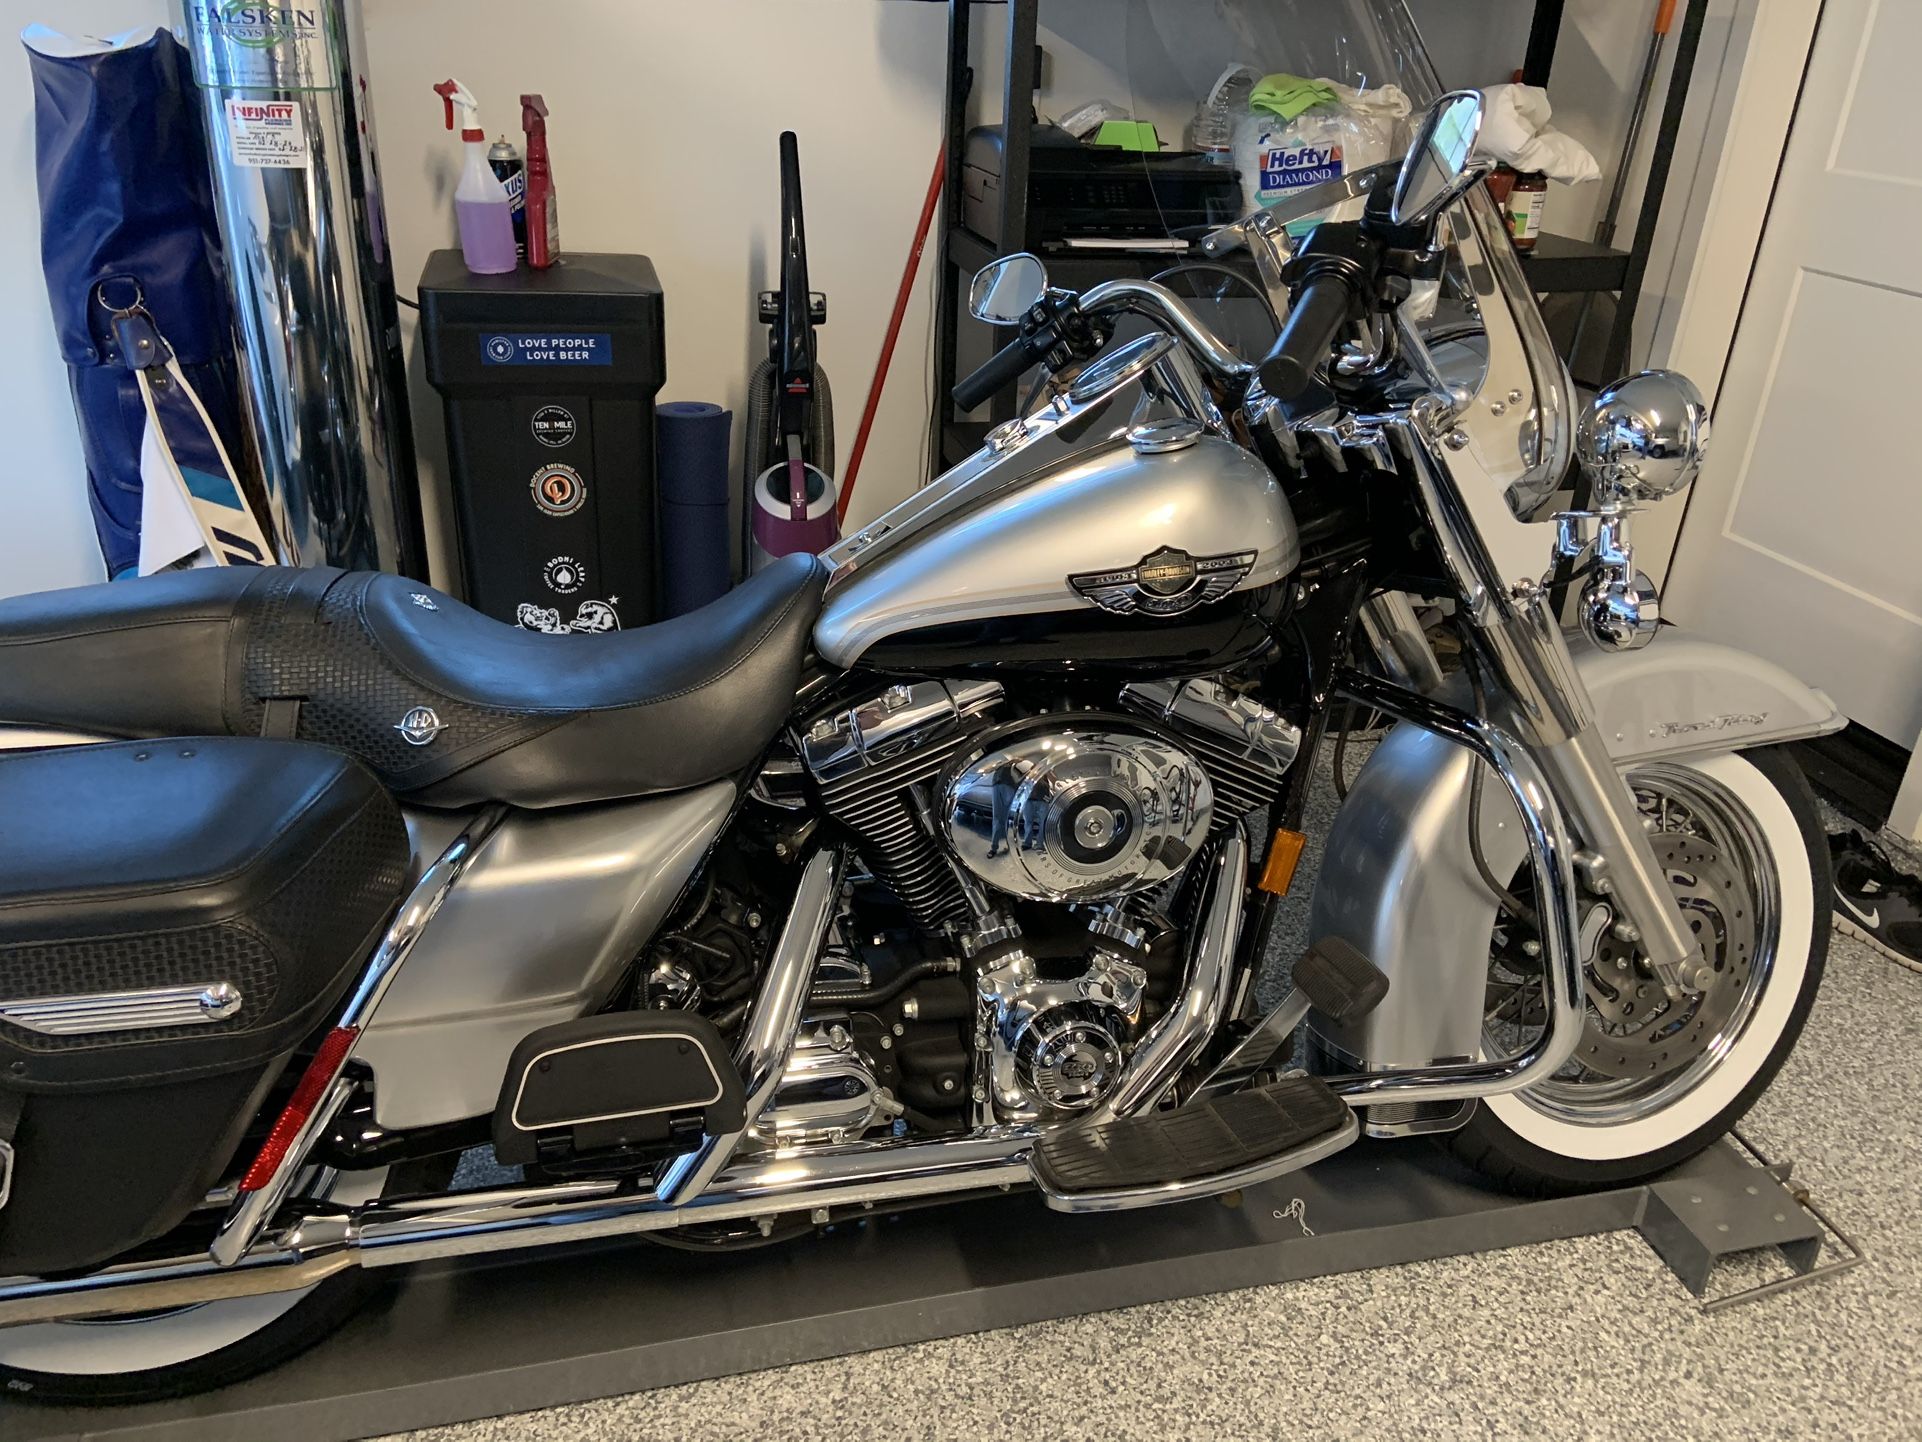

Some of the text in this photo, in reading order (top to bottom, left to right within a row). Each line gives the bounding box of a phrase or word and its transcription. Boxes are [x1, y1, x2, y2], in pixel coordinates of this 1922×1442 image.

[194, 6, 316, 27] FALSKEN
[196, 27, 236, 37] WATER
[231, 104, 293, 121] INFINITY
[1269, 148, 1330, 169] Hefty
[504, 174, 523, 197] XUS
[1269, 168, 1332, 187] DIAMOND
[518, 339, 596, 348] LOVE PEOPLE
[526, 351, 590, 360] LOVE BEER
[535, 420, 573, 429] TEN MILE
[546, 463, 576, 473] BREWING
[547, 556, 586, 582] BODHI LEAF
